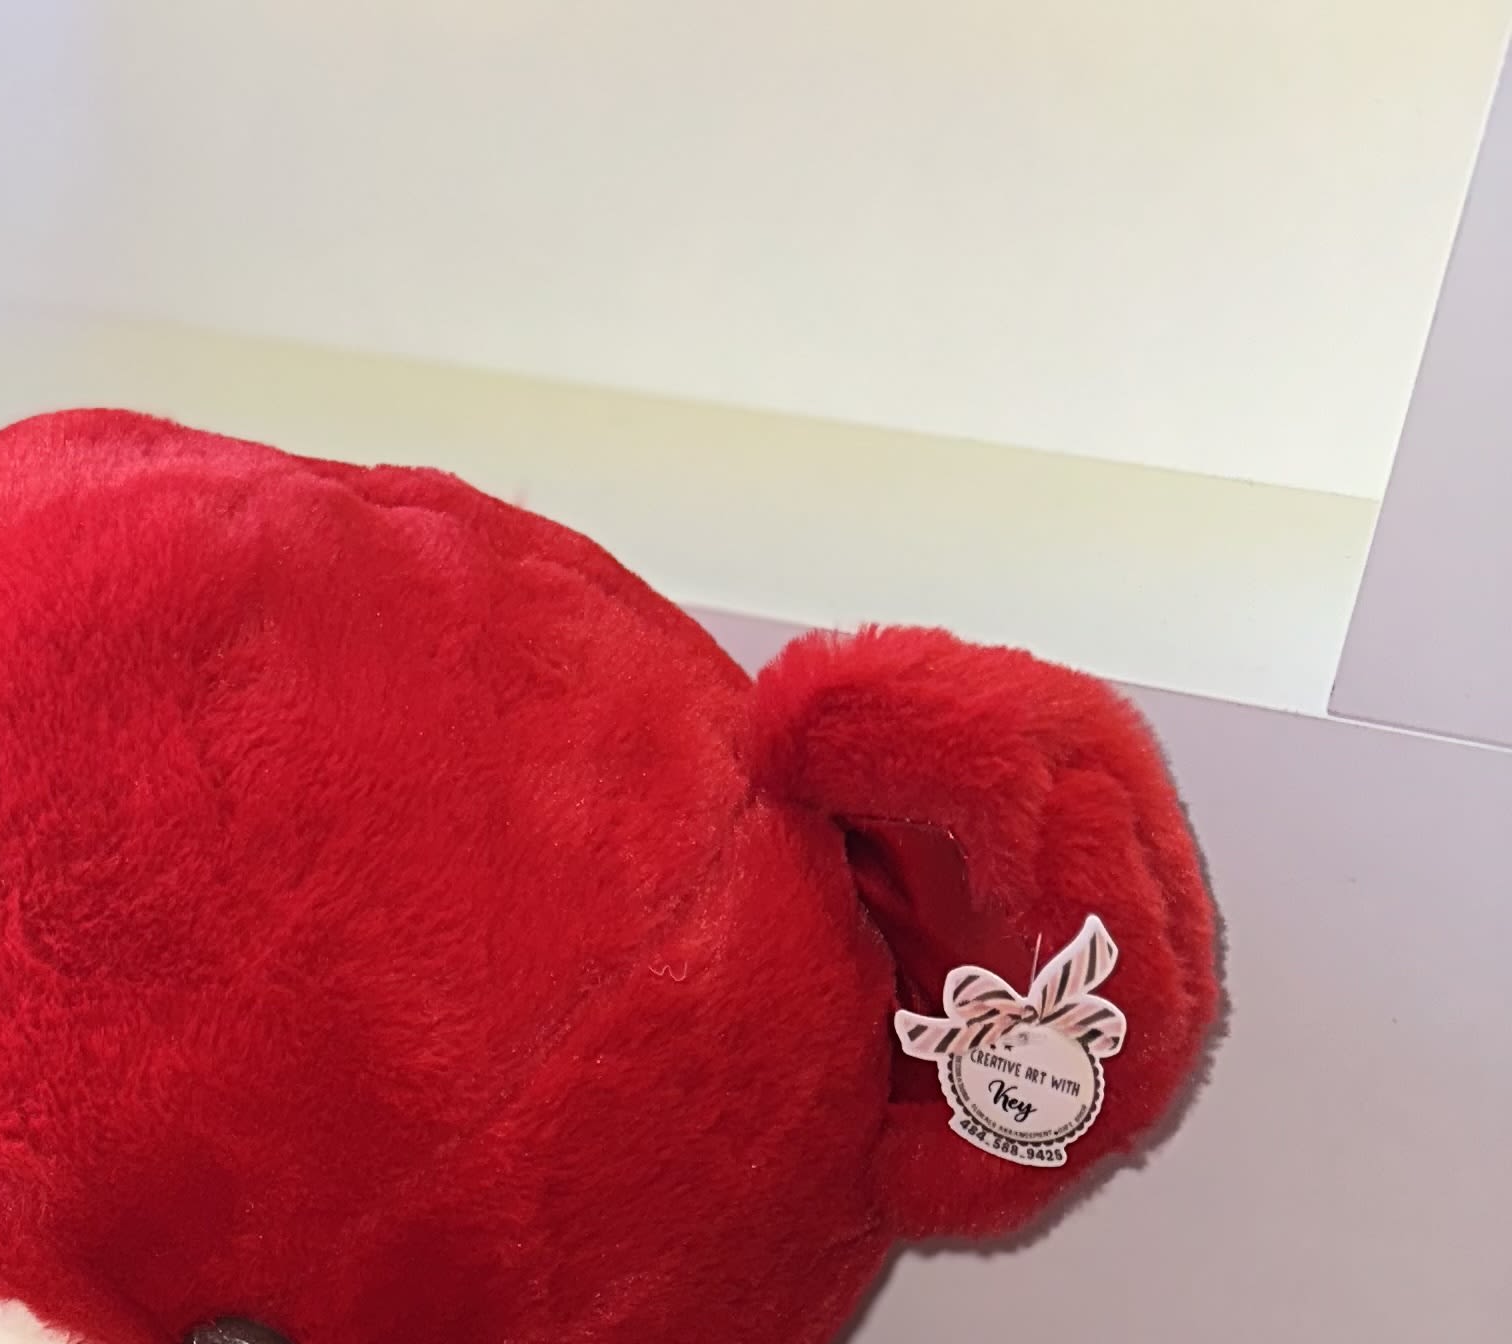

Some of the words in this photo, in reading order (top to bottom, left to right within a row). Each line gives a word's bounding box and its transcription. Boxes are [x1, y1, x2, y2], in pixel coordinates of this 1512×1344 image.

[970, 1049, 1021, 1077] CREATIVE
[1025, 1067, 1048, 1085] ART
[1051, 1075, 1081, 1097] WITH
[988, 1079, 1037, 1122] Key
